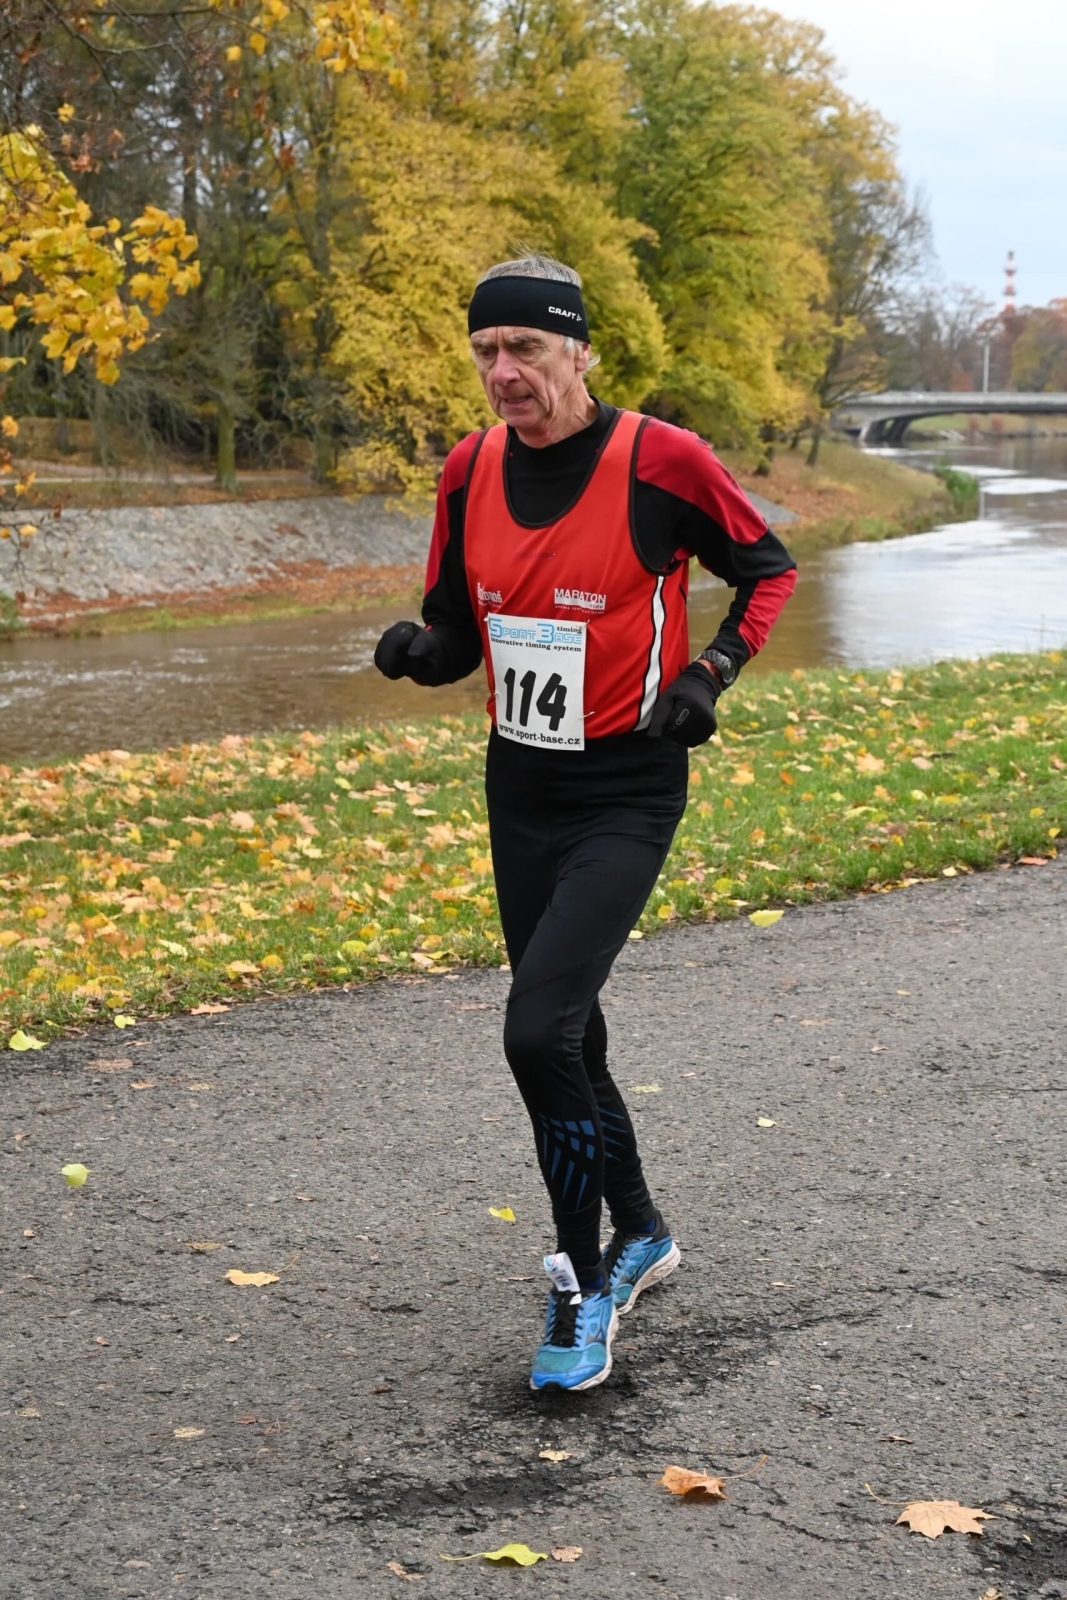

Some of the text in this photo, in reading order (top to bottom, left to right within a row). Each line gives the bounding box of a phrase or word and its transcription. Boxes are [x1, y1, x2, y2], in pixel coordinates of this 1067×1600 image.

[548, 306, 576, 320] CRAFT
[554, 588, 607, 604] MARATON
[556, 626, 583, 634] timing
[490, 637, 523, 647] innovative
[525, 642, 551, 650] timing
[504, 667, 567, 732] 114
[498, 723, 581, 745] www.sport-base.cz
